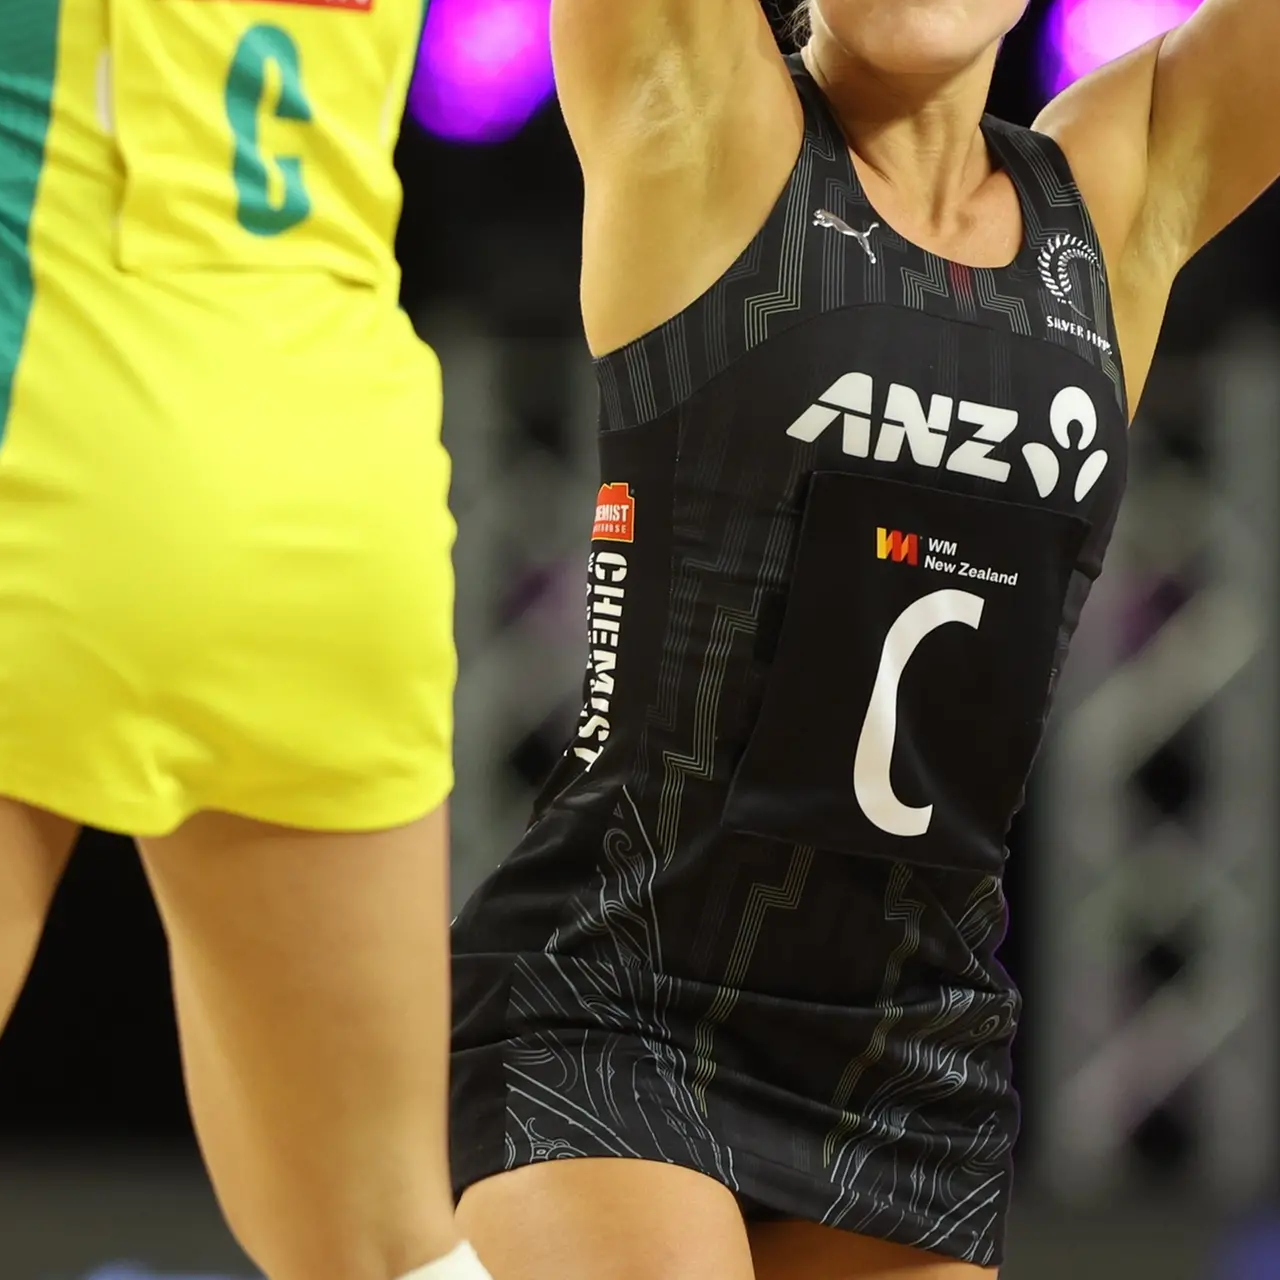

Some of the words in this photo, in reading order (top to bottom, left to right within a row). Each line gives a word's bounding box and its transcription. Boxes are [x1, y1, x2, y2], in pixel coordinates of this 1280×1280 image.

[224, 21, 313, 237] C
[1046, 315, 1085, 339] SILVER
[786, 371, 1019, 483] ANZ
[923, 555, 956, 574] New
[957, 562, 1019, 587] Zealand
[927, 537, 958, 556] WM
[573, 551, 628, 773] CHEMIST
[853, 588, 985, 837] C
